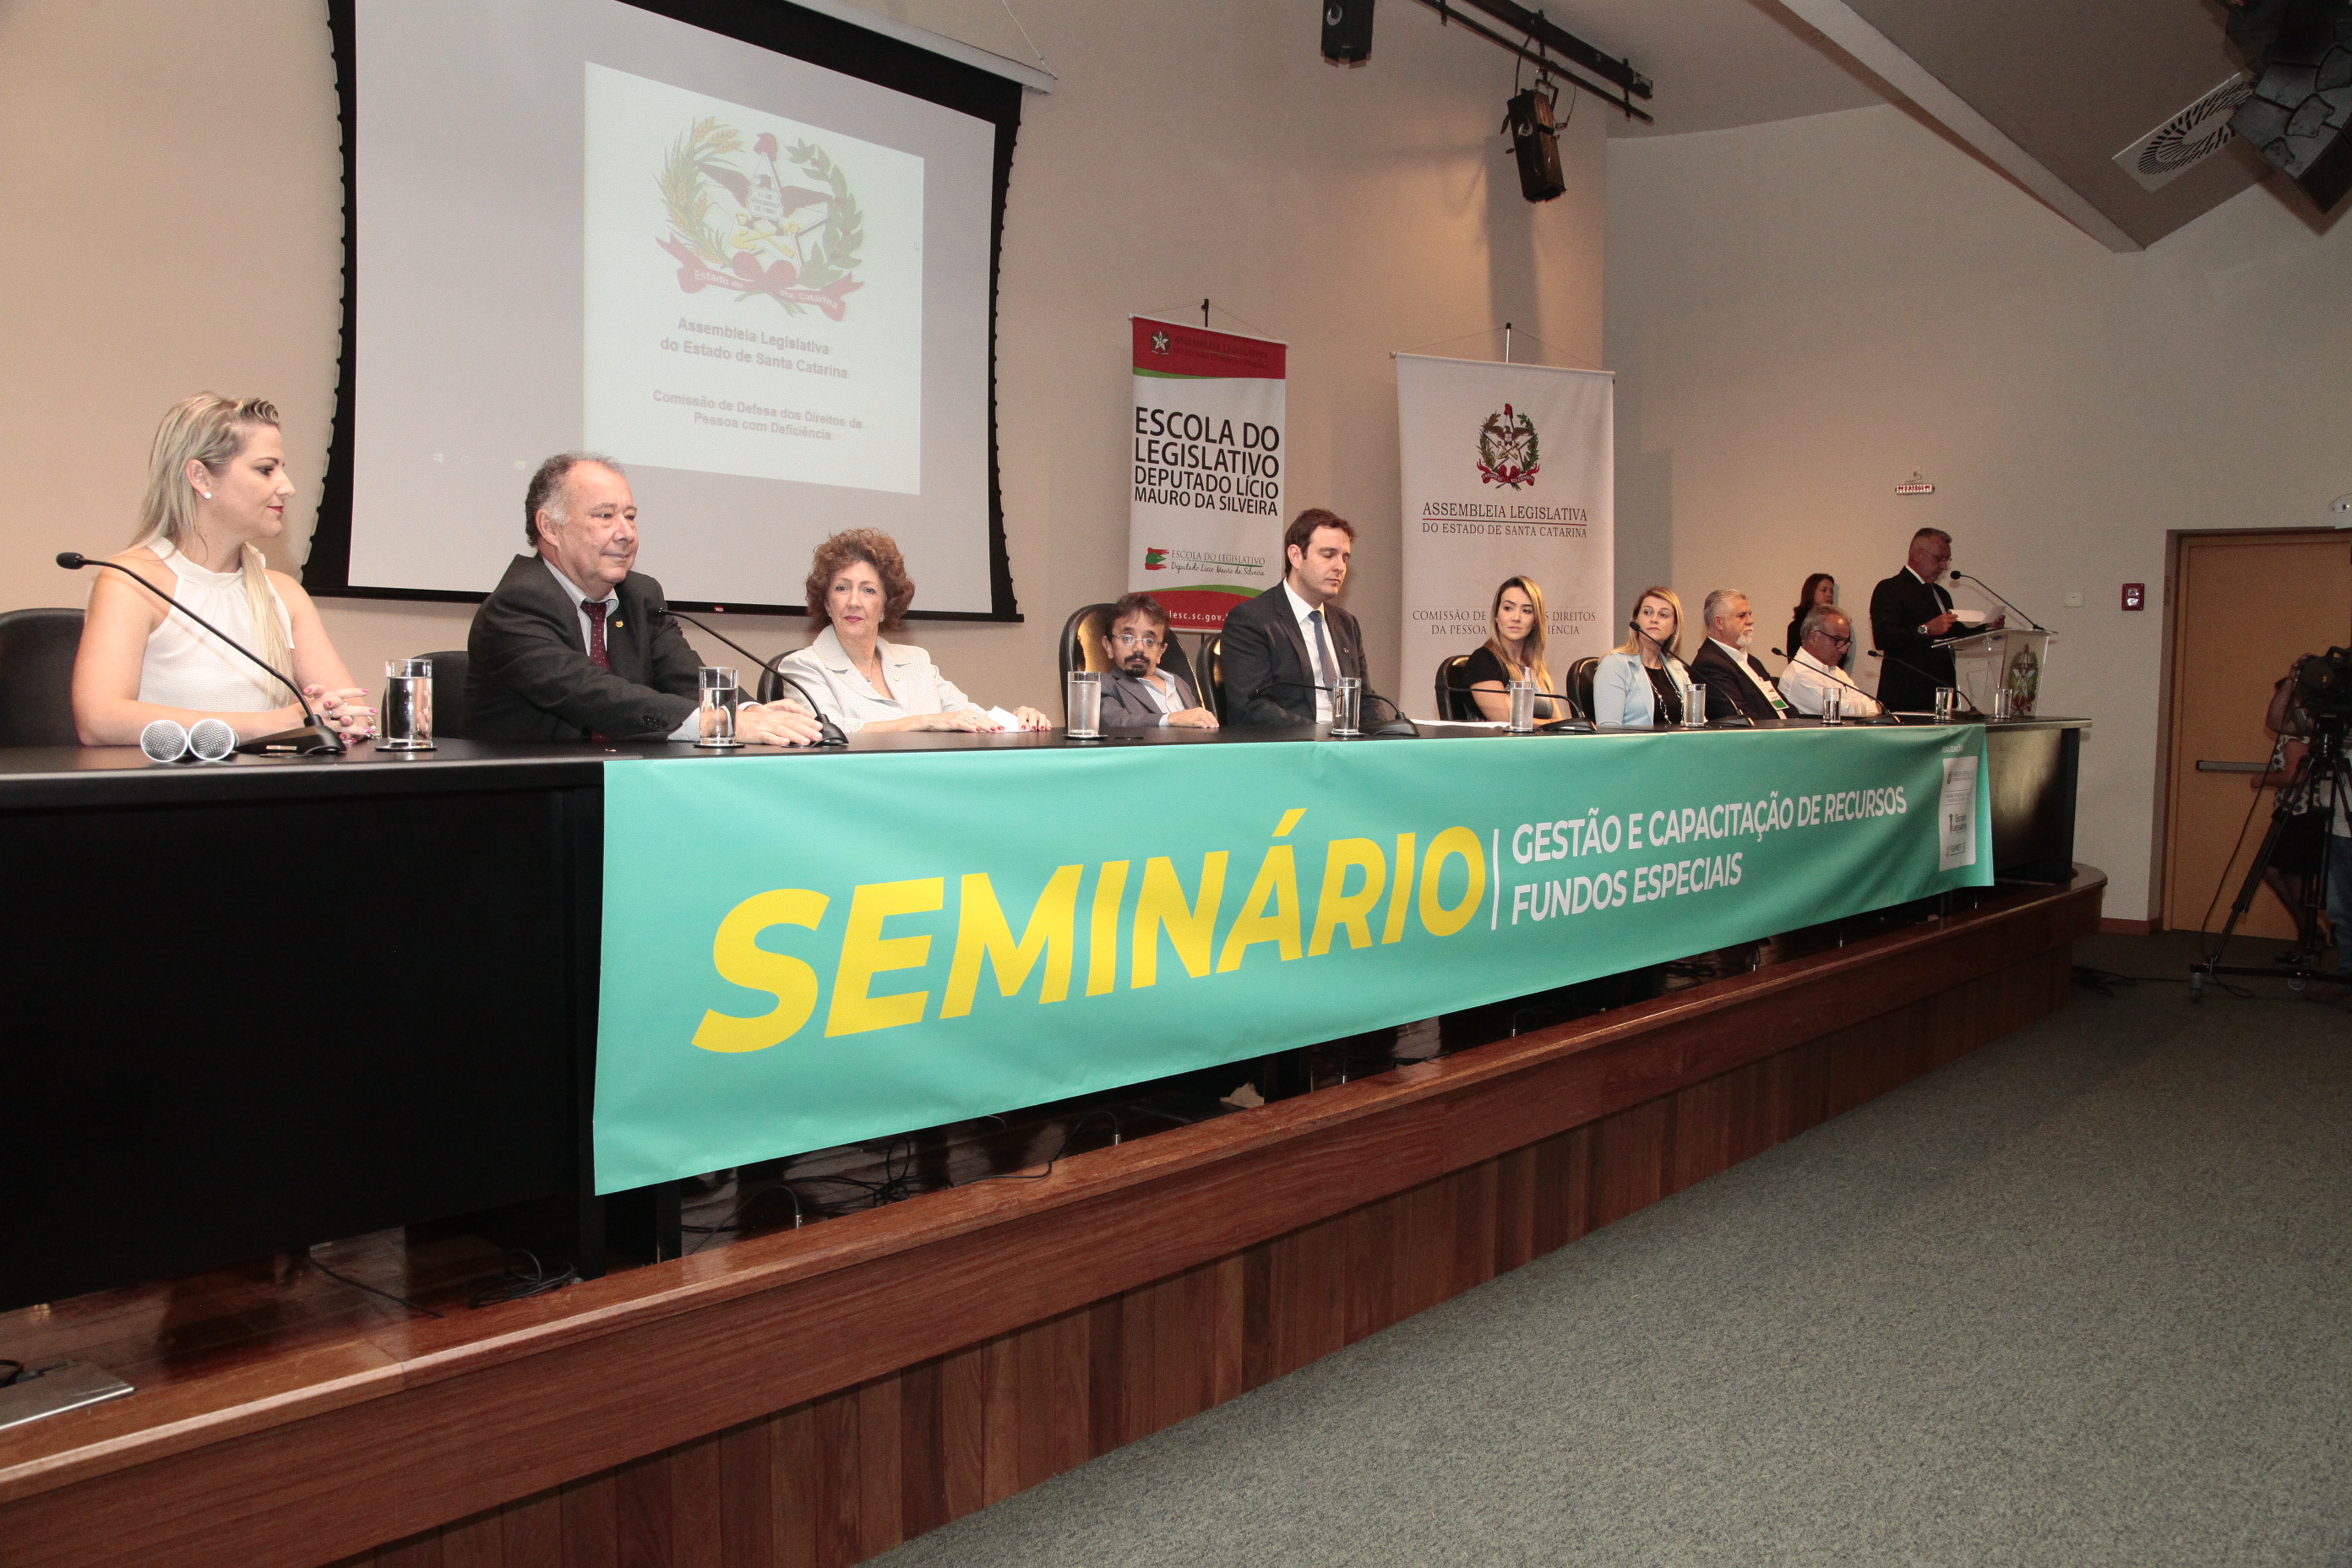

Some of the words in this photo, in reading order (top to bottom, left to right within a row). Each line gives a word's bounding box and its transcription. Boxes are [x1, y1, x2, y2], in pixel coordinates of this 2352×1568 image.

[677, 317, 756, 342] Assembleia
[760, 331, 830, 355] Legislativa
[660, 337, 678, 351] do
[683, 340, 731, 360] Estado
[735, 349, 752, 362] de
[755, 352, 792, 370] Santa
[796, 359, 848, 379] Catarina
[652, 389, 715, 409] Comissão
[718, 399, 732, 411] de
[737, 401, 776, 417] Defesa
[780, 408, 801, 422] dos
[804, 411, 846, 427] Direitos
[848, 417, 863, 429] da
[694, 411, 738, 428] Pessoa
[742, 421, 766, 432] com
[770, 422, 831, 440] Deficiência
[1135, 406, 1235, 447] ESCOLA
[1243, 422, 1280, 452] DO
[1135, 437, 1280, 478] LEGISLATIVO
[1135, 465, 1232, 494] DEPUTADO
[1236, 475, 1279, 499] LÍCIO
[1135, 486, 1191, 507] MAURO
[1195, 493, 1216, 509] DA
[1219, 495, 1278, 516] SILVEIRA
[1423, 502, 1506, 518] ASSEMBLEIA
[1510, 505, 1587, 521] LEGISLATIVA
[1422, 522, 1439, 533] DO
[1442, 523, 1484, 534] ESTADO
[1488, 525, 1501, 535] DE
[1505, 525, 1537, 536] SANTA
[1539, 526, 1587, 538] CATARINA
[1171, 561, 1199, 574] Deputado
[1216, 565, 1233, 574] Mauro
[1234, 566, 1242, 574] da
[1244, 566, 1265, 576] Silveira
[1172, 549, 1201, 560] ESCOLA
[1204, 553, 1217, 561] DO
[1218, 553, 1266, 565] LEGISLATIVO
[1413, 608, 1470, 621] COMISSÃO
[1473, 610, 1486, 621] DE
[1431, 624, 1446, 634] DA
[1450, 624, 1487, 634] PESSOA
[1552, 611, 1596, 622] DIREITOS
[1512, 807, 1622, 864] GESTÃO
[1628, 812, 1643, 850] E
[1648, 791, 1794, 847] CAPACITAÇÃO
[1797, 794, 1822, 827] DE
[1824, 786, 1908, 824] RECURSOS
[1511, 869, 1628, 925] FUNDOS
[1632, 852, 1743, 904] ESPECIAIS
[690, 807, 1487, 1054] SEMINÁRIO
